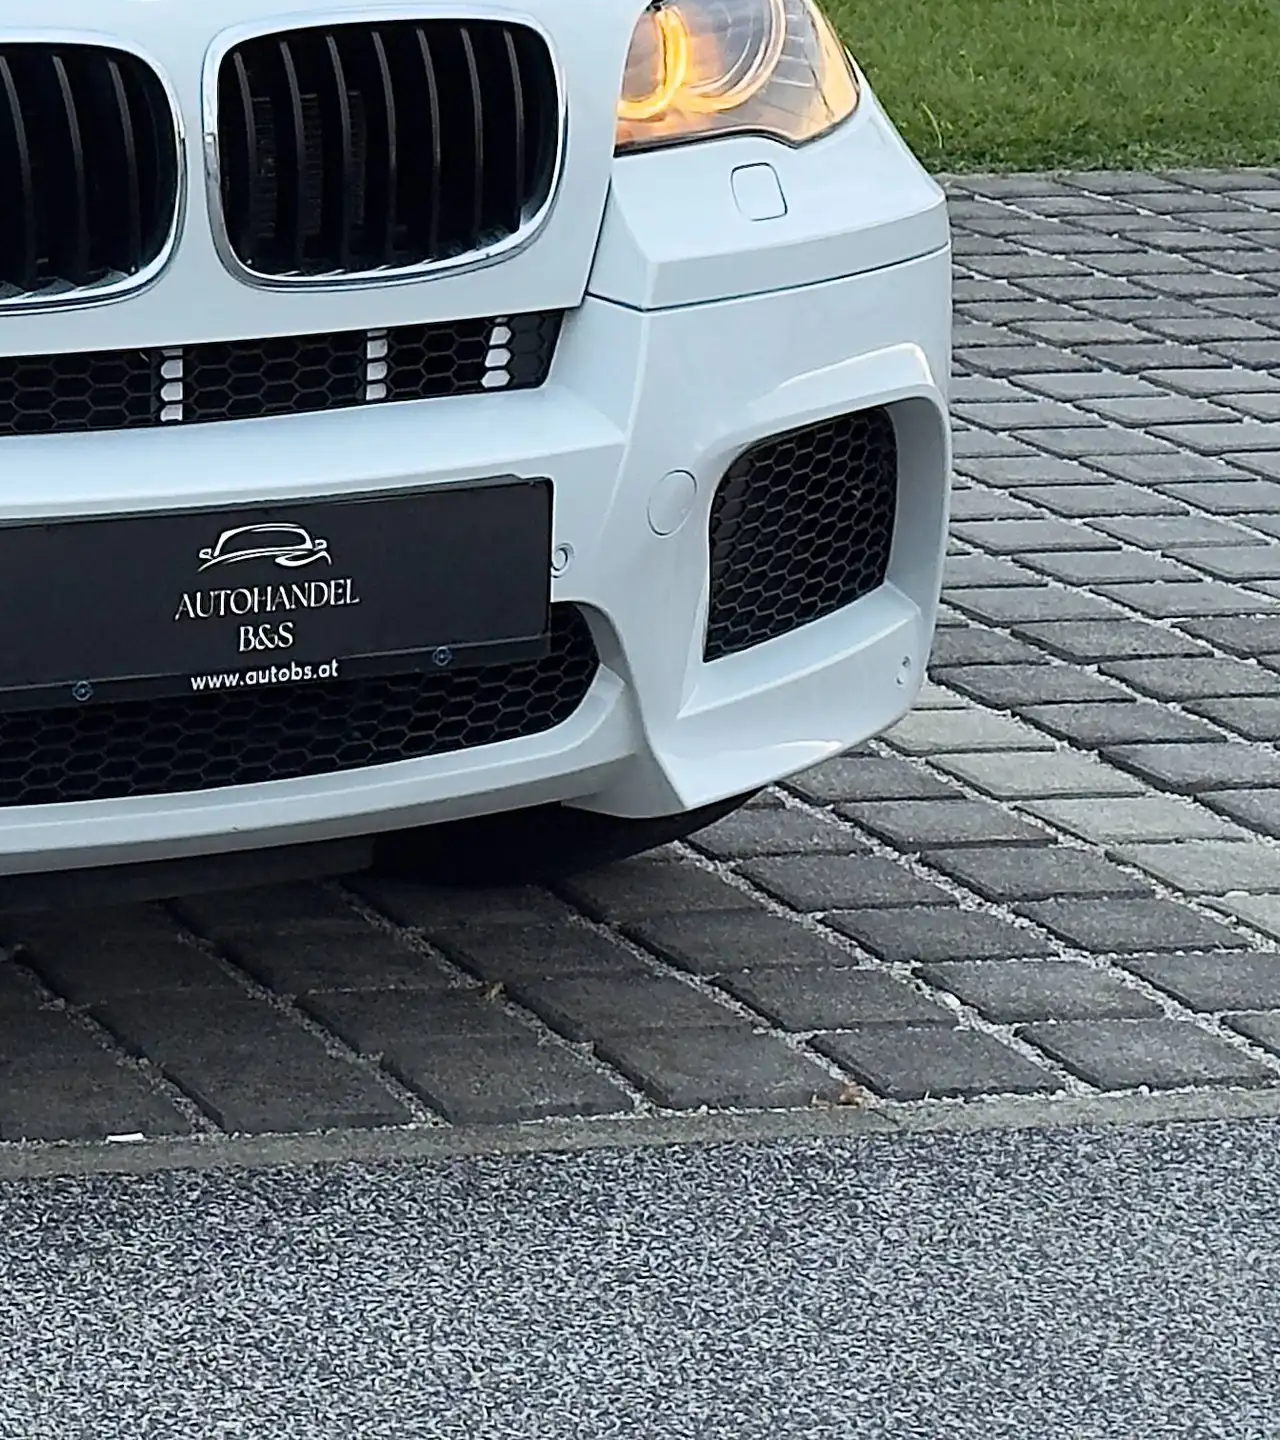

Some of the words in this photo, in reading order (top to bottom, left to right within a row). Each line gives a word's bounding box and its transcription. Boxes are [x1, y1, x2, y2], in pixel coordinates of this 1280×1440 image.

[174, 578, 360, 621] AUTOHANDEL
[238, 622, 294, 652] B&S
[190, 658, 339, 691] www.autobs.at
